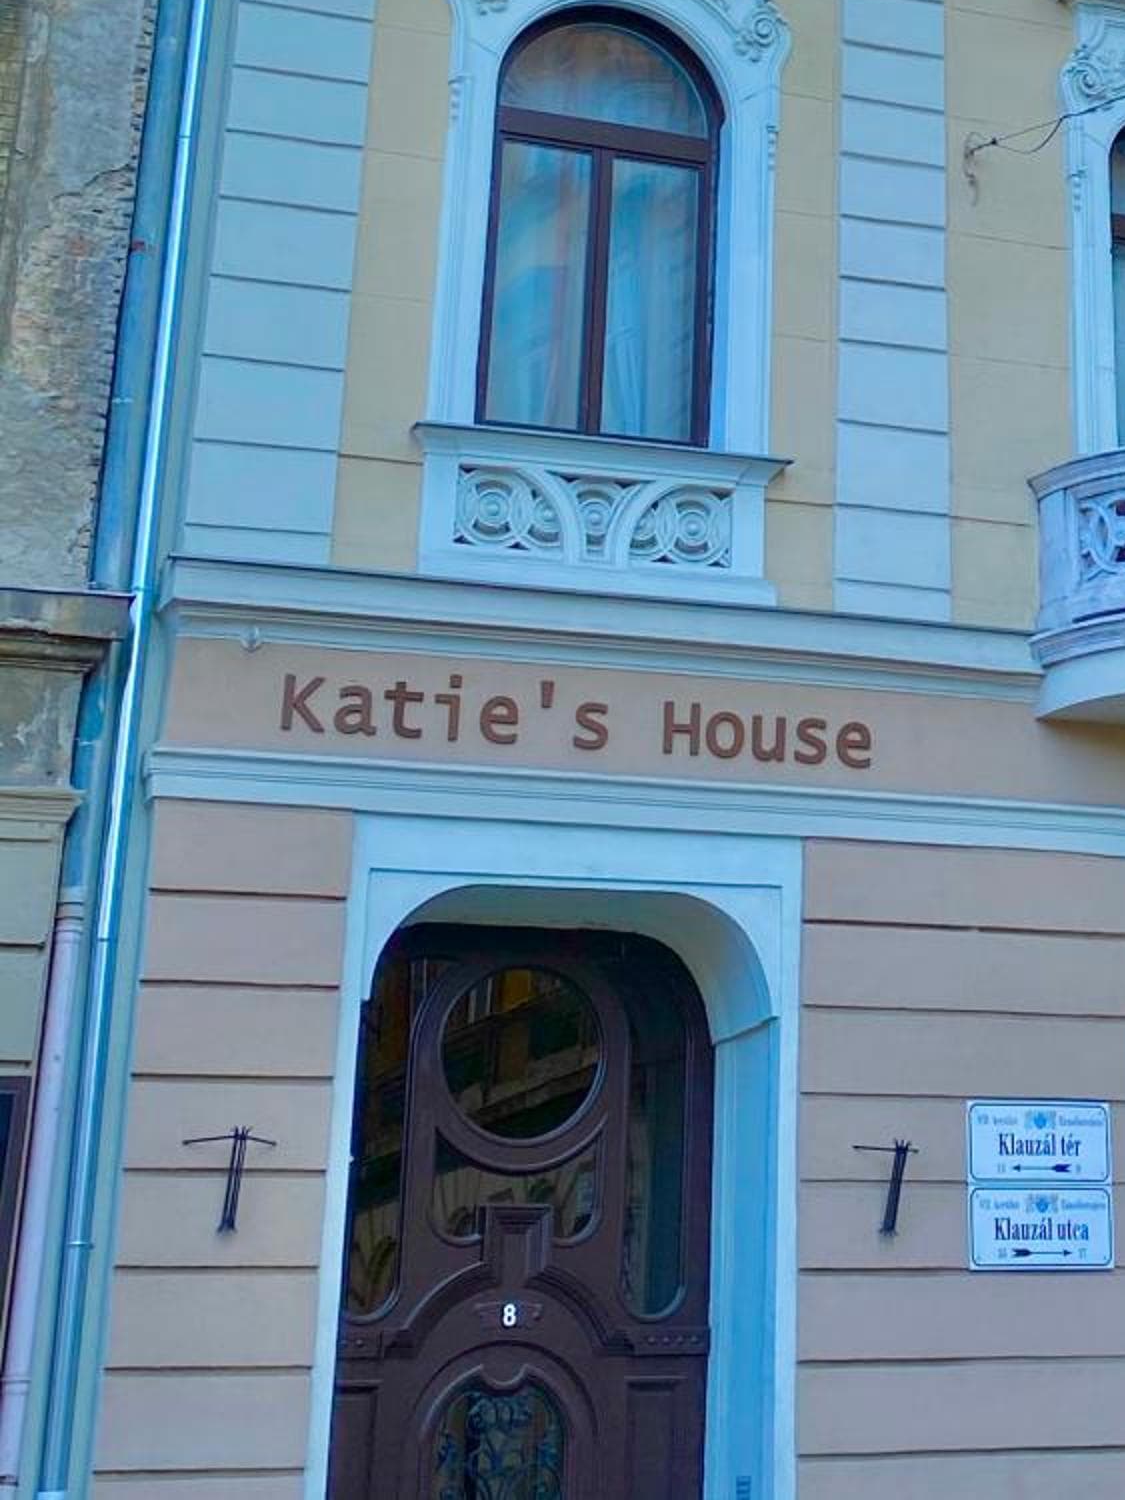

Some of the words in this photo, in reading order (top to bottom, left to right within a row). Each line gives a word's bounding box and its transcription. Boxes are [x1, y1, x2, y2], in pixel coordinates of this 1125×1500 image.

[279, 673, 609, 751] Katie's
[662, 700, 873, 770] House
[998, 1131, 1056, 1157] Klauzál
[1061, 1132, 1082, 1157] tér
[994, 1217, 1053, 1241] Klauzál
[1057, 1219, 1089, 1241] utca
[503, 1303, 517, 1327] 8
